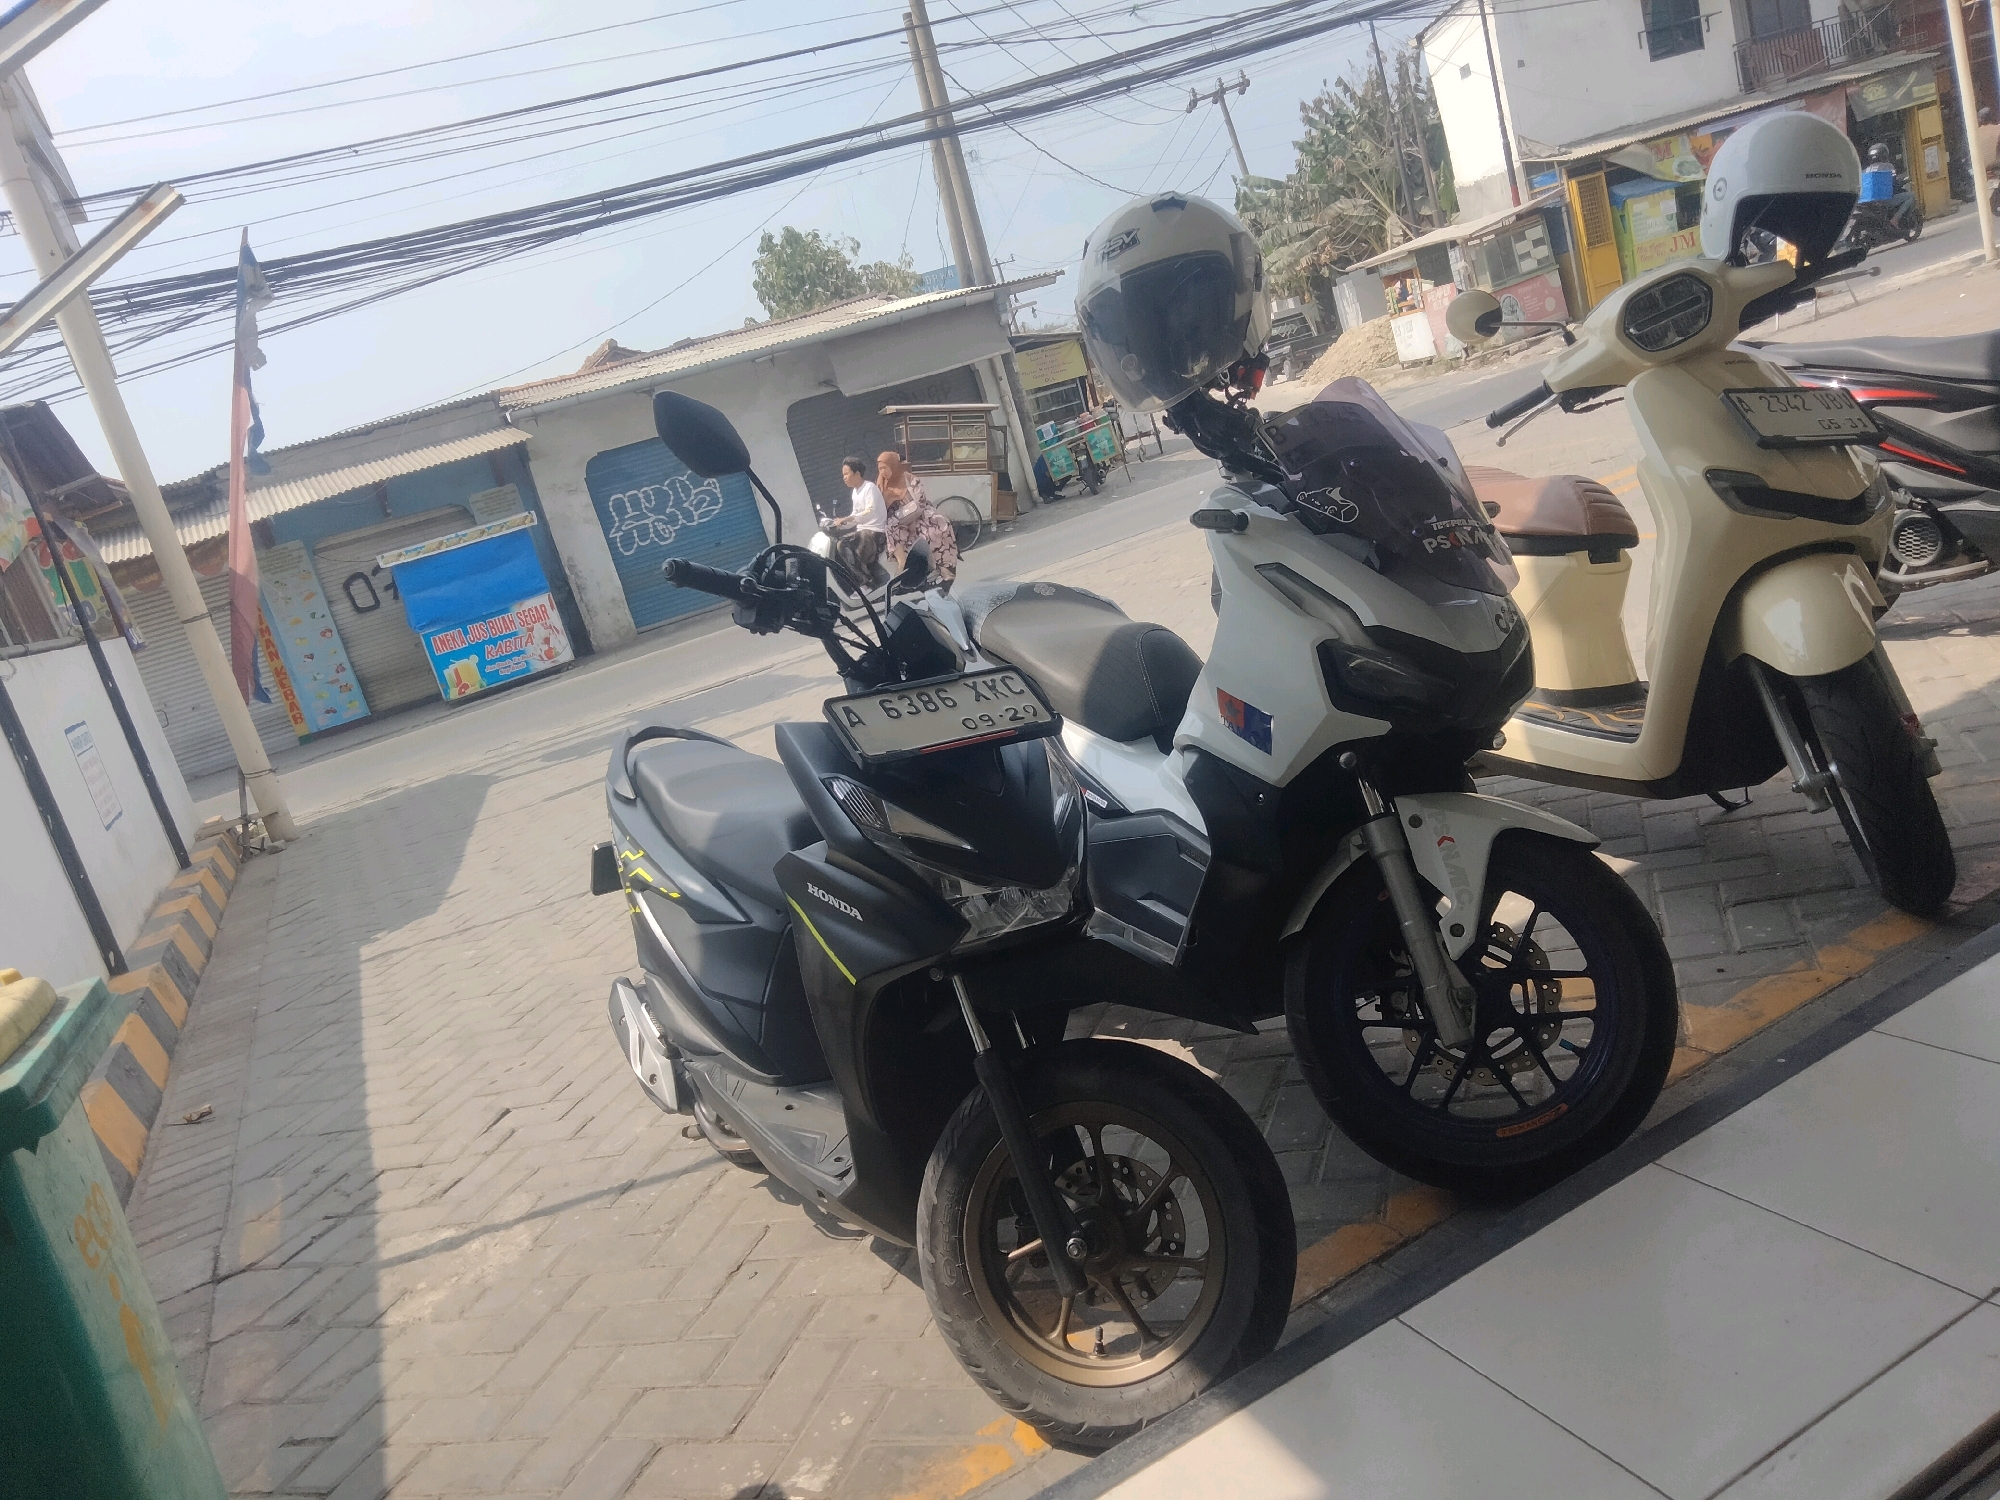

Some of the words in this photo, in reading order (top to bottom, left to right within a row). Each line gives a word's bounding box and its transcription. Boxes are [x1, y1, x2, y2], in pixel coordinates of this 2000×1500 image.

[1669, 231, 1697, 253] JM
[1736, 396, 1754, 414] A
[1759, 395, 1812, 412] 2342
[1813, 391, 1854, 410] VBV
[431, 628, 467, 654] ANEKA
[467, 622, 490, 643] JUS
[487, 614, 517, 635] BUAH
[516, 603, 550, 628] SEGAR
[485, 633, 535, 660] KABITA
[274, 665, 304, 726] KEBAB
[841, 705, 867, 728] A
[878, 687, 958, 720] 6386
[962, 674, 1026, 702] XKC
[807, 881, 864, 922] HONDA
